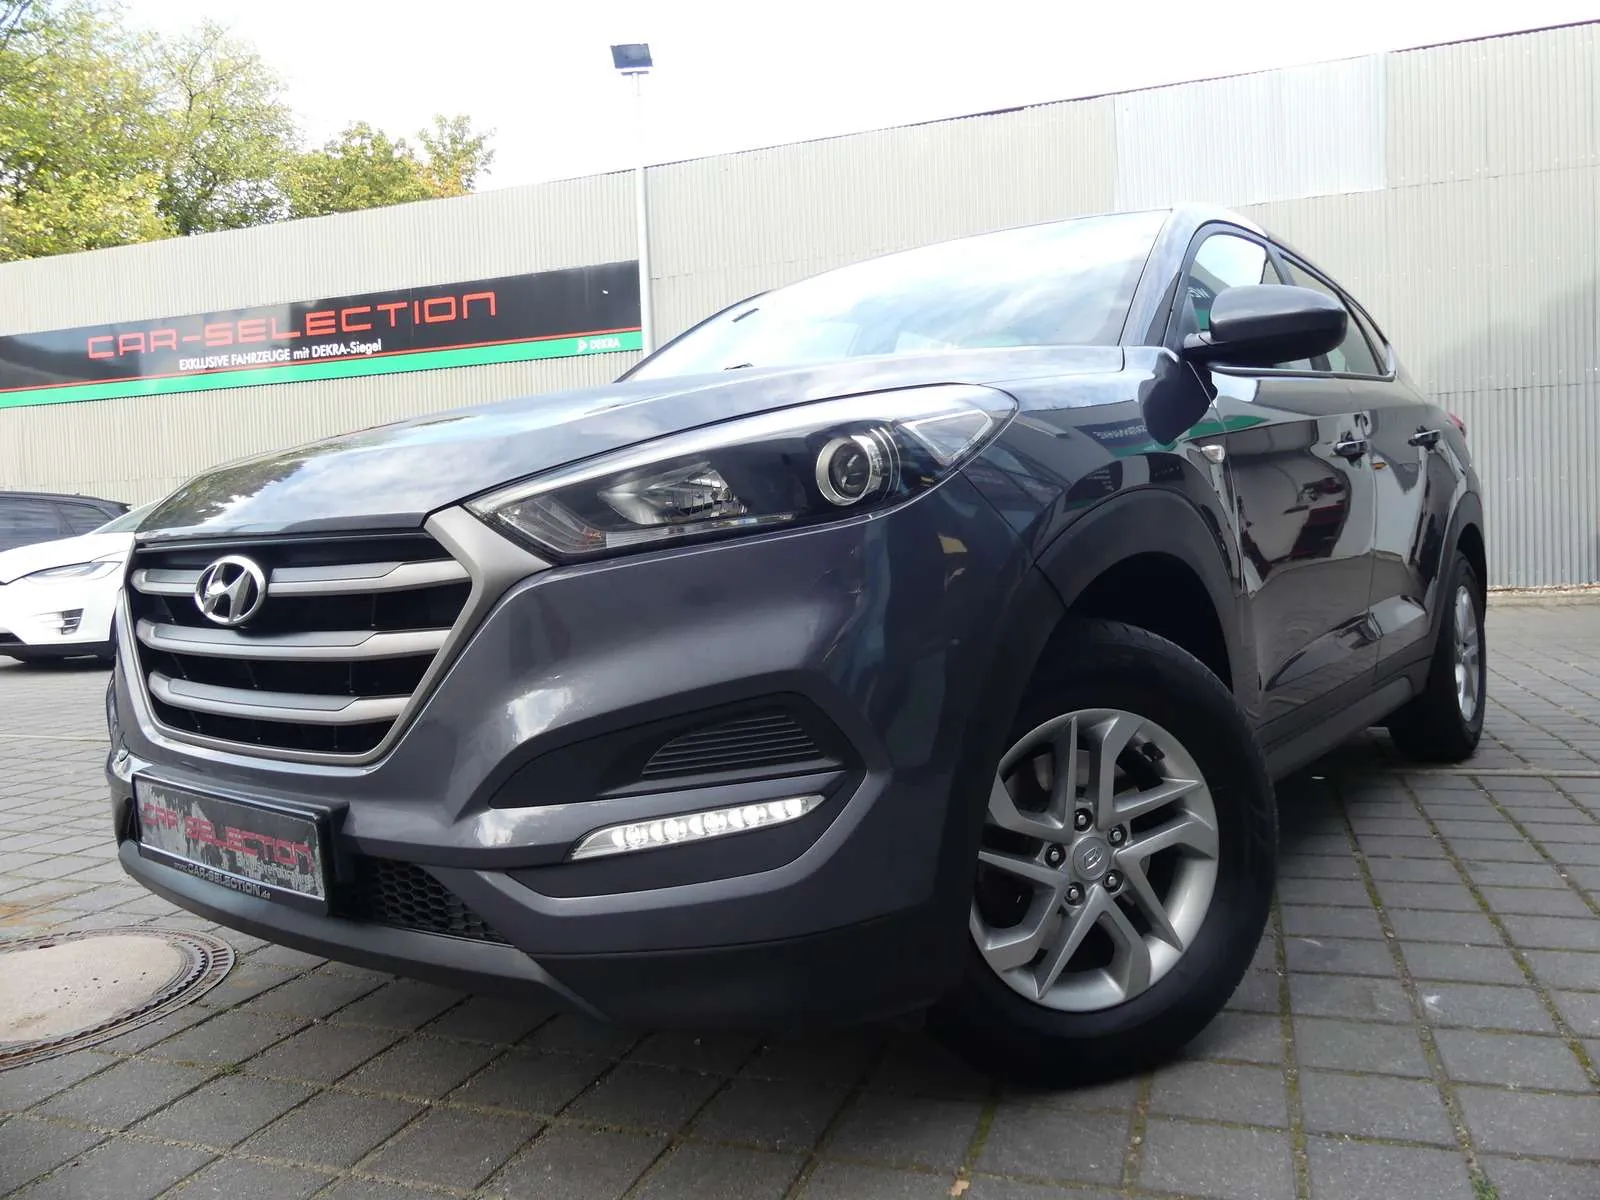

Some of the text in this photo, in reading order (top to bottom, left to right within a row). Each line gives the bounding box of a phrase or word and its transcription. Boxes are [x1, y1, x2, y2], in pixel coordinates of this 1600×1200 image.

[87, 291, 496, 359] CAR-SELECTION
[178, 337, 382, 371] EXKLUSIVE FAHRZEUGE mit DEKRA-Siegel
